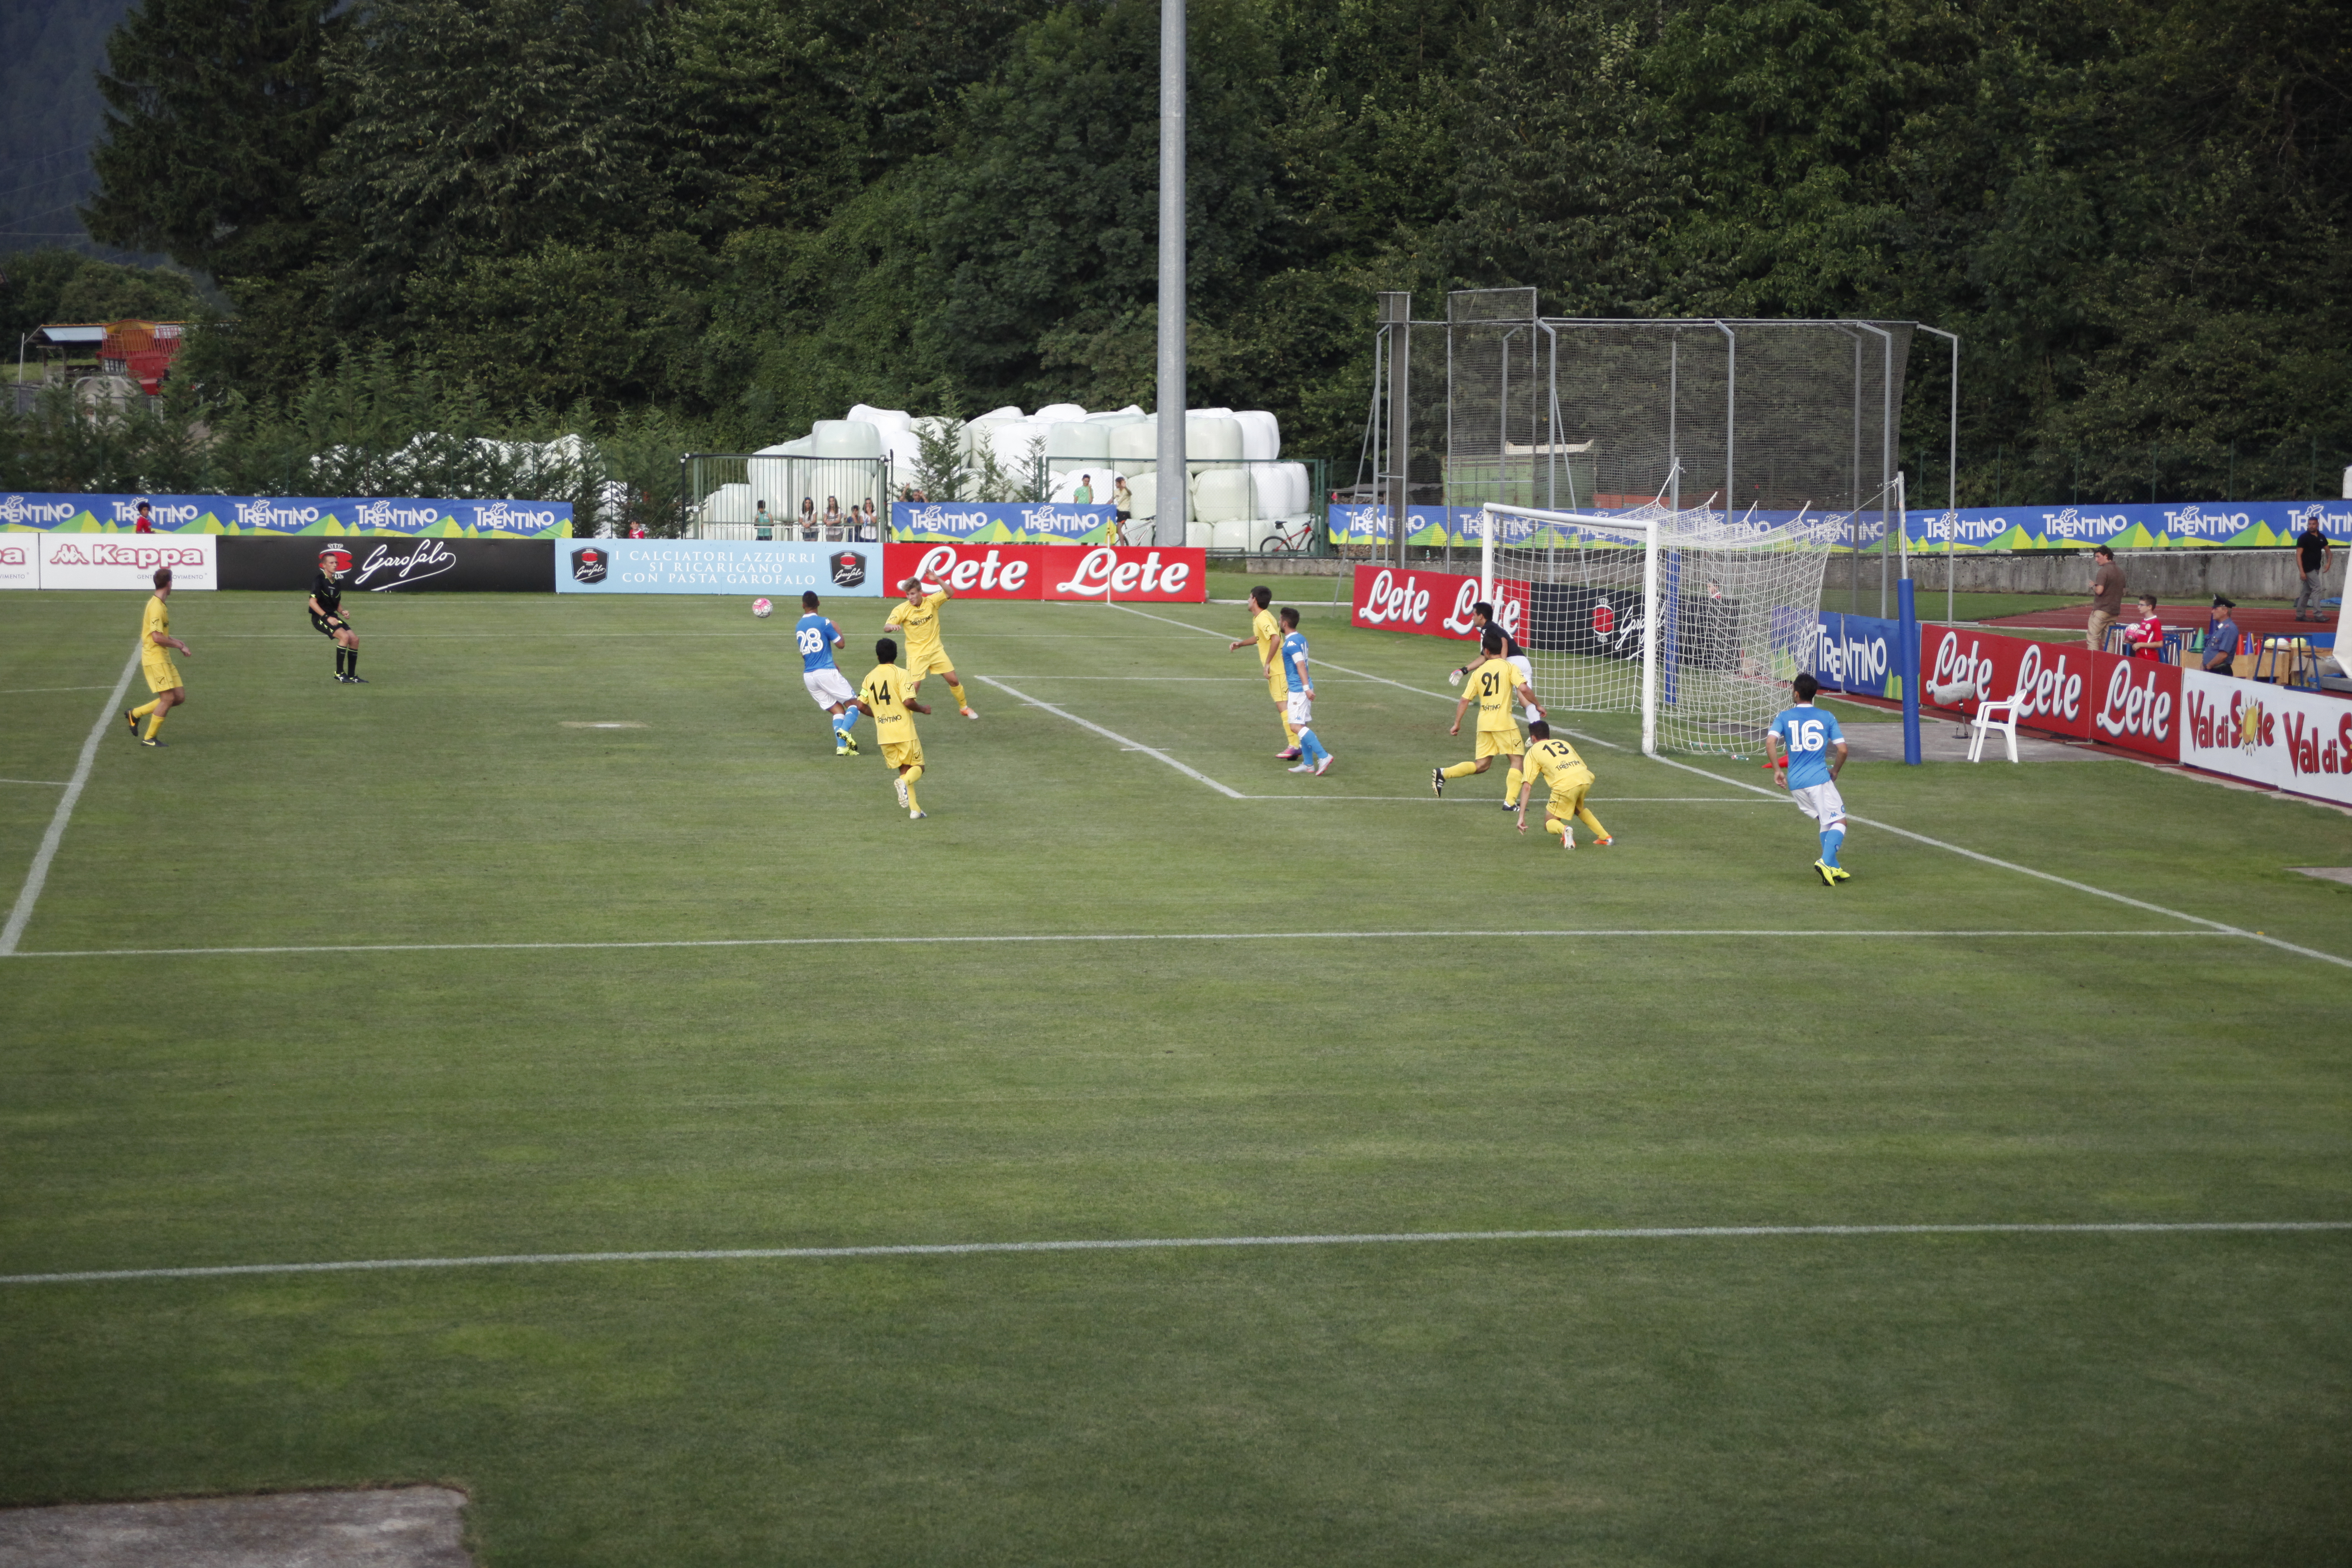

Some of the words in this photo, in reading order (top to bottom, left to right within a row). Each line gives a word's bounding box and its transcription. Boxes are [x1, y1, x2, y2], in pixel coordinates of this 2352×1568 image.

[0, 503, 75, 523] RENTINO
[235, 503, 319, 527] TRENTINO
[355, 505, 438, 527] TRENTINO
[473, 507, 554, 529] TRENTINO
[909, 509, 987, 531] TRENTINO
[1021, 510, 1099, 532] TRENTINO
[2164, 512, 2249, 535] TRENTINO
[2043, 514, 2127, 537] TRENTINO
[93, 544, 204, 569] Kappa
[355, 539, 456, 585] Garofalo
[616, 551, 619, 560] I
[629, 551, 734, 561] CALCIATORI
[742, 552, 816, 563] AZZURRI
[650, 562, 663, 572] SI
[674, 562, 783, 573] RICARICANO
[574, 564, 606, 580] Garofalo
[622, 573, 658, 583] CON
[668, 573, 718, 583] PASTA
[727, 573, 816, 585] GAROFALO
[833, 567, 864, 582] Garofalo
[897, 545, 1029, 594] Lete
[1056, 548, 1189, 596] Lete
[1359, 570, 1430, 625] Lete
[1443, 579, 1521, 635] Lte
[796, 628, 823, 655] 28
[1817, 624, 1887, 686] TRENTINO
[1926, 631, 1993, 702] Lete
[870, 680, 891, 705] 14
[1481, 671, 1500, 697] 21
[2007, 645, 2081, 722] Lete
[2097, 660, 2171, 742] Lete
[877, 714, 902, 724] TRENTINO
[1788, 720, 1824, 752] 16
[1542, 741, 1569, 758] 13
[1555, 760, 1580, 771] TRENTIN
